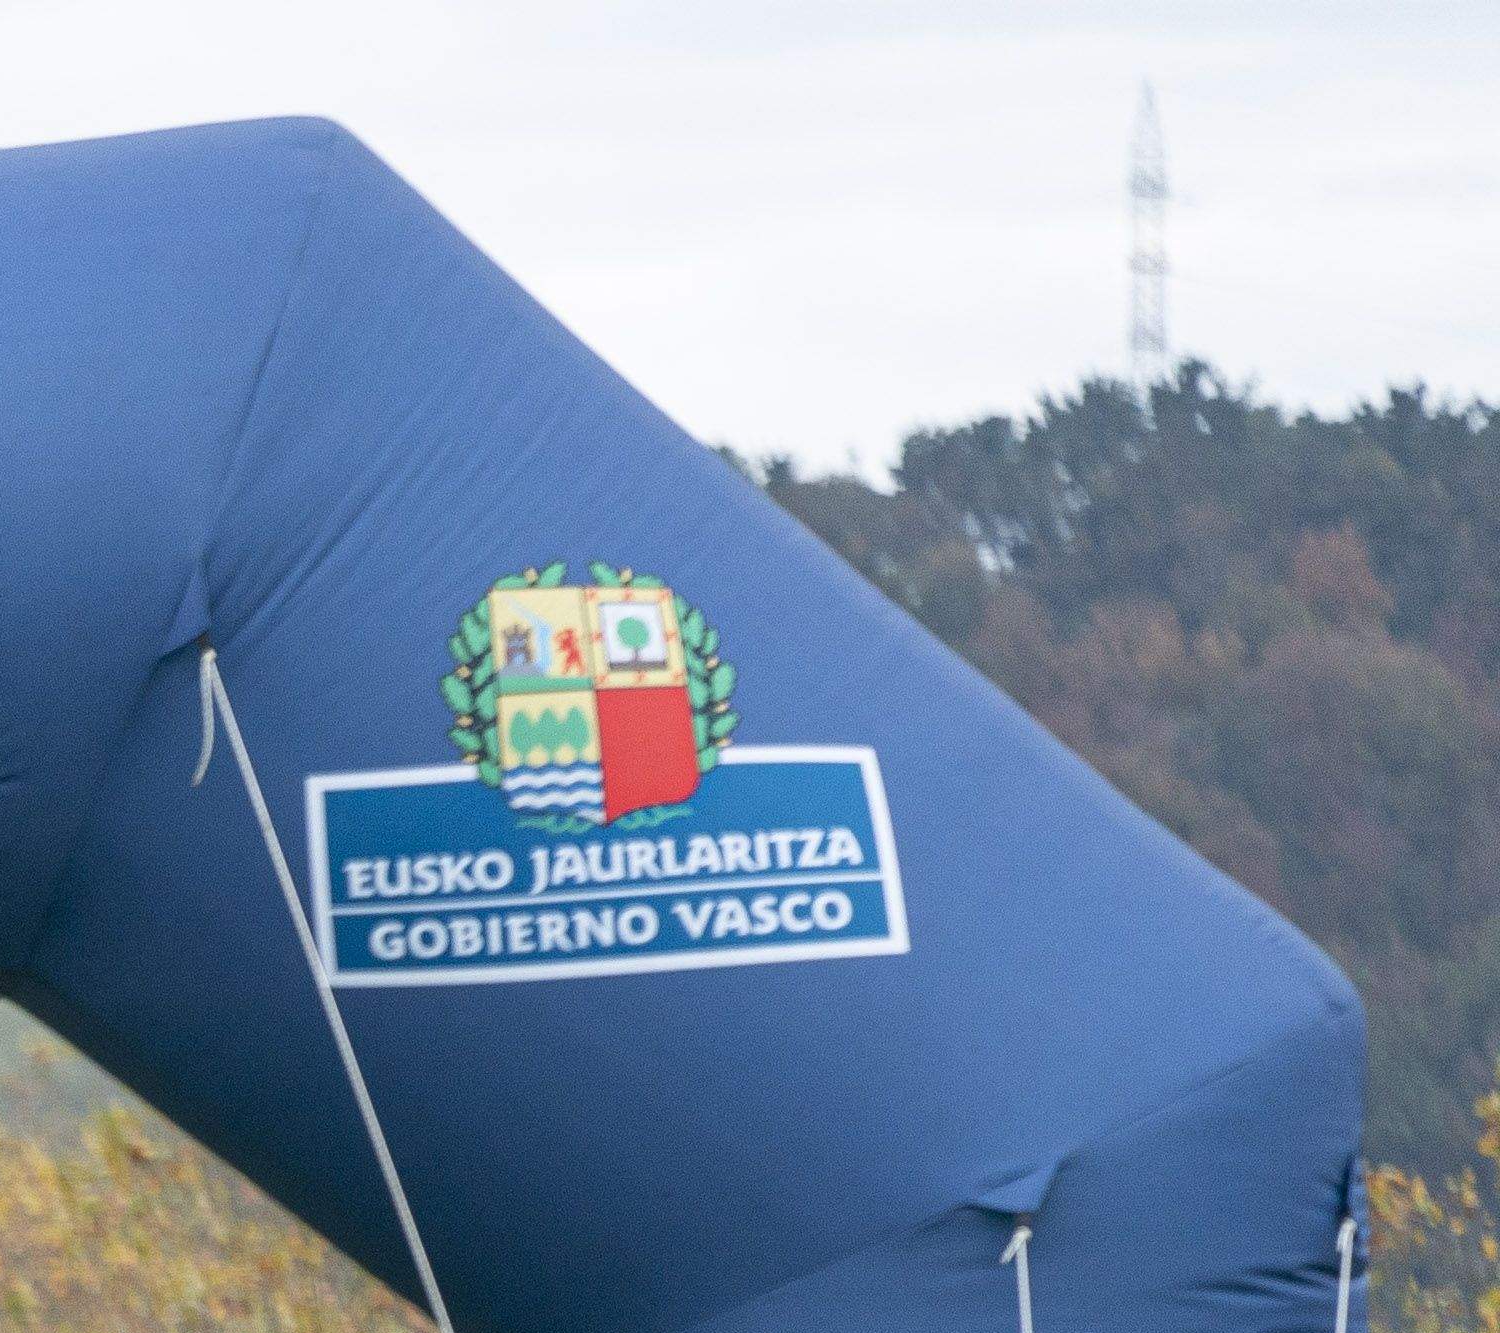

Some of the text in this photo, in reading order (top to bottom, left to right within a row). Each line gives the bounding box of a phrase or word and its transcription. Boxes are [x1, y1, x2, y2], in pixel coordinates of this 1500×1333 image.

[343, 827, 864, 899] EUSKO JAURLARITZA
[368, 891, 854, 961] GOBIERNO VASCO
